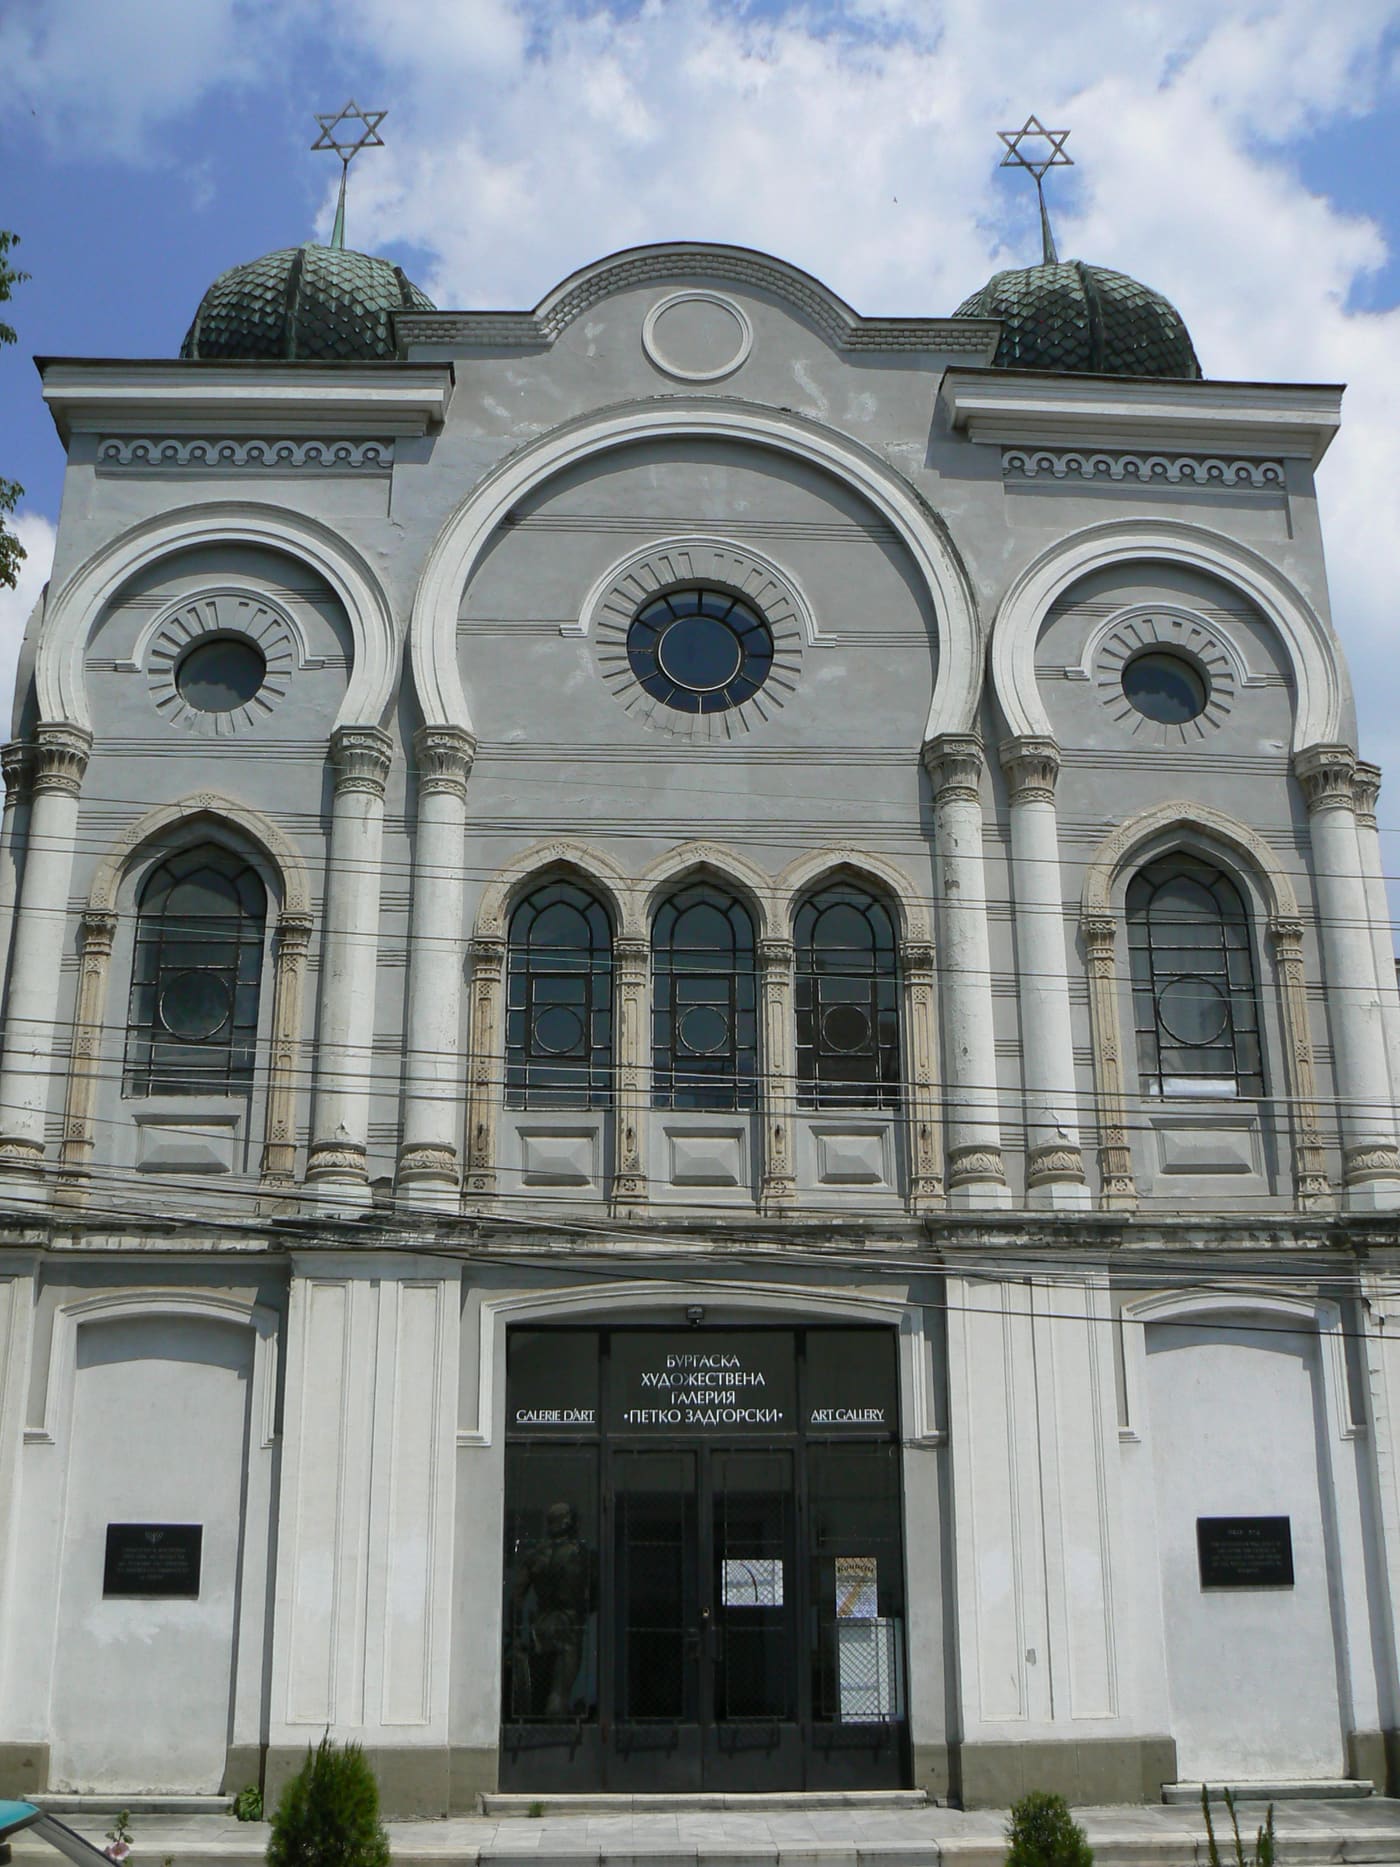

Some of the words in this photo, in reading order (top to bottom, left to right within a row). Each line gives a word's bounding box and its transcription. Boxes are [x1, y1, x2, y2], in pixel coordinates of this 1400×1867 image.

[666, 1354, 740, 1368] БУРГАСКА
[641, 1372, 766, 1389] ХУДОЖЕСТВЕНА
[671, 1390, 736, 1404] ГАЛЕРИЯ
[516, 1409, 561, 1421] GALERIE
[563, 1408, 595, 1421] D'ART
[811, 1409, 834, 1422] ART
[835, 1408, 885, 1421] GALLERY
